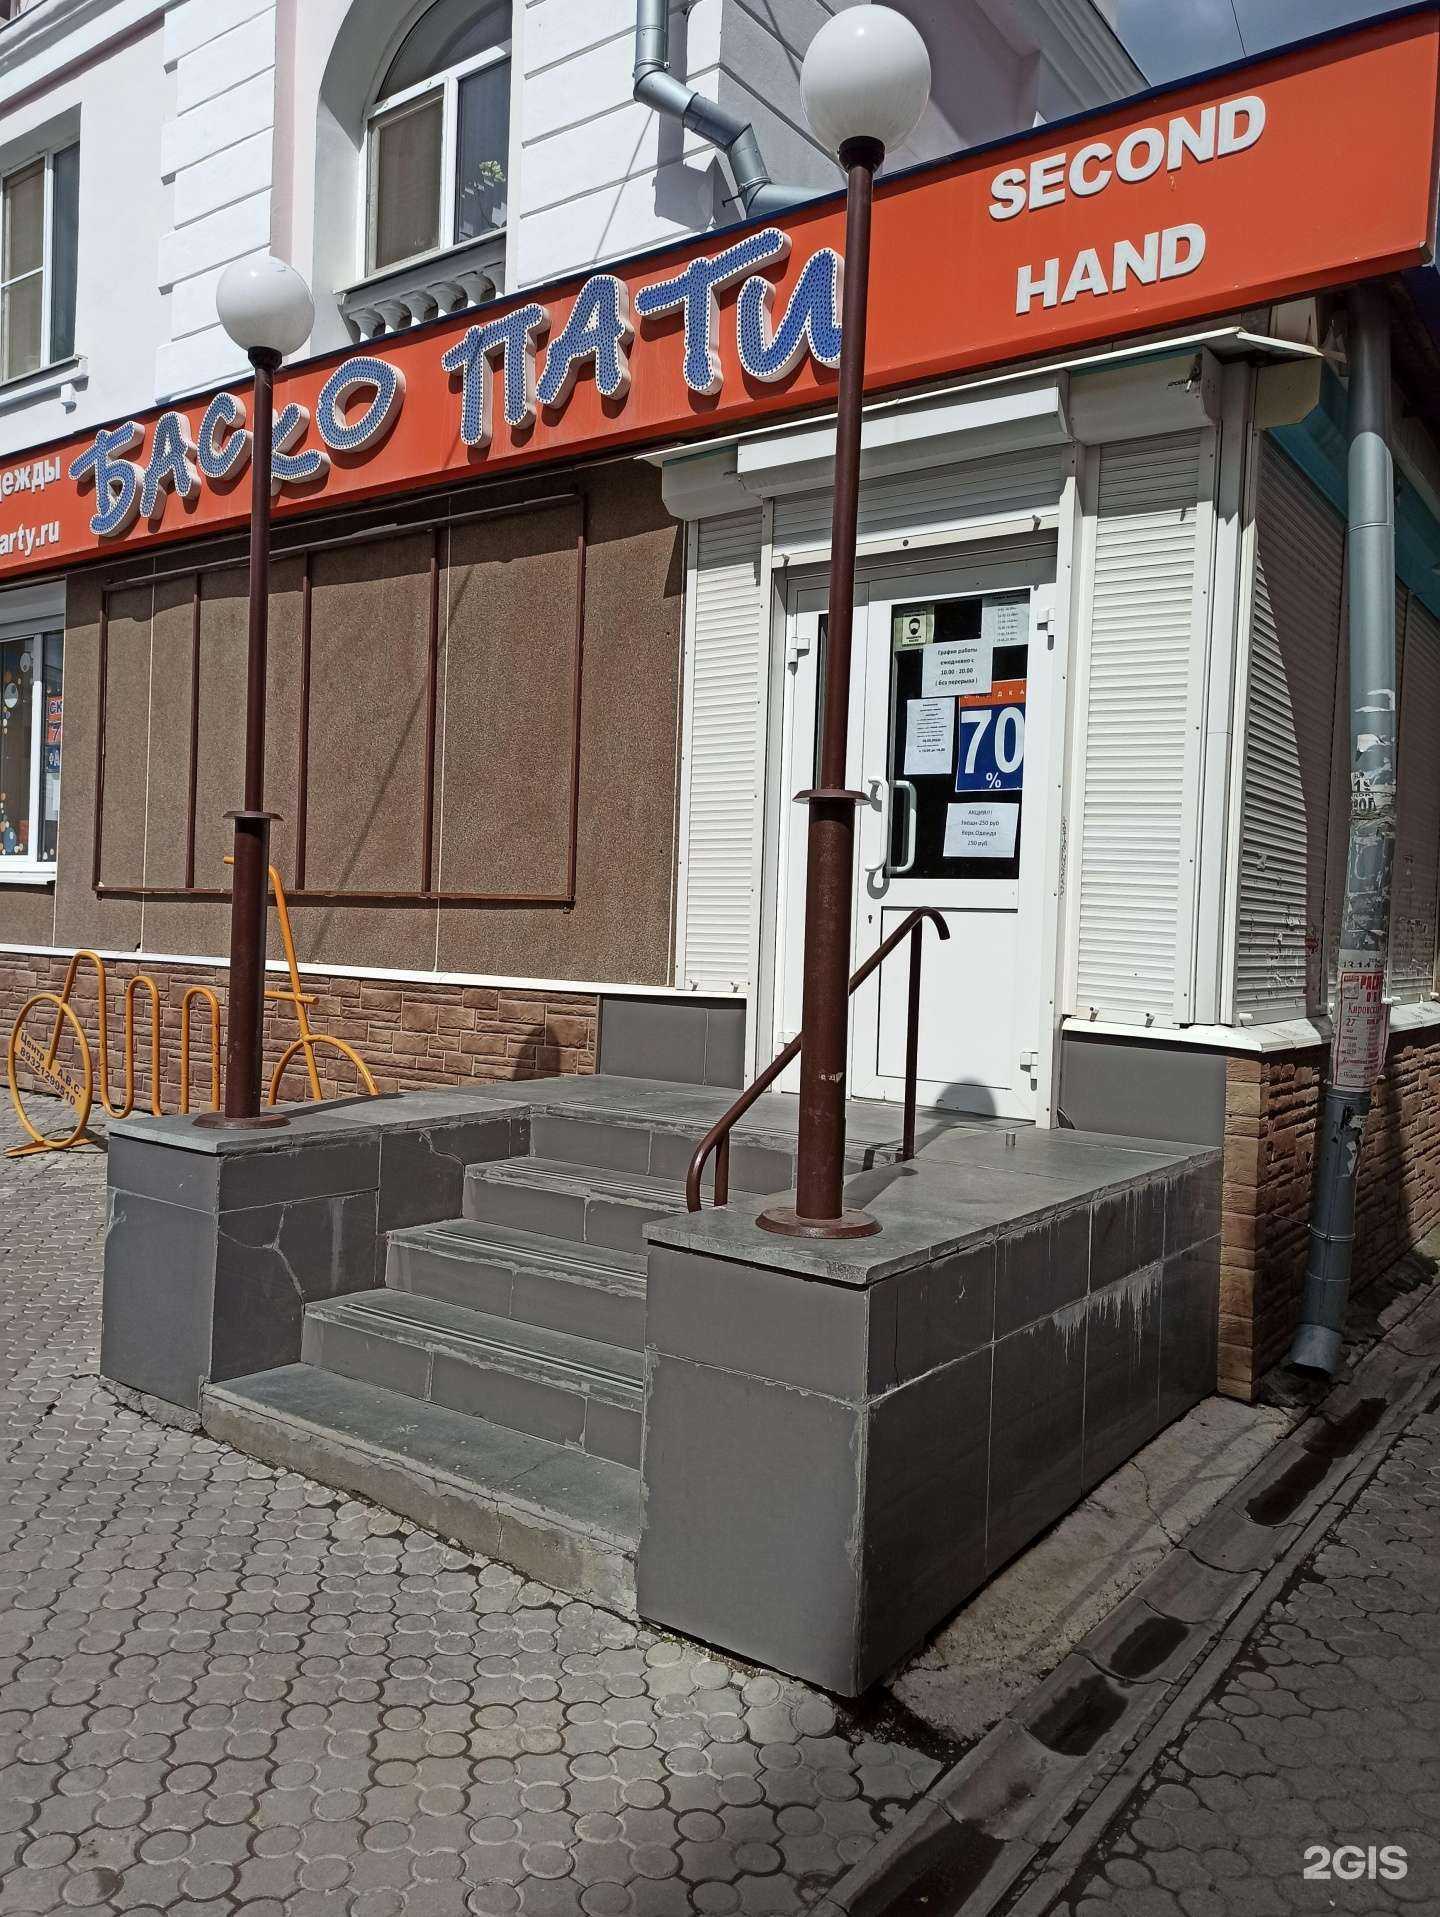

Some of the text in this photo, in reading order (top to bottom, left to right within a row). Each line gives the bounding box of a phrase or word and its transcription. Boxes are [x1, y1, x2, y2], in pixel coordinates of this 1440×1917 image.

[988, 95, 1266, 221] SECOND
[1016, 222, 1207, 316] HAND
[0, 456, 61, 502] ежды
[961, 706, 1024, 774] 70
[985, 772, 1002, 789] %
[989, 820, 1000, 828] руб
[20, 1031, 46, 1062] Центр
